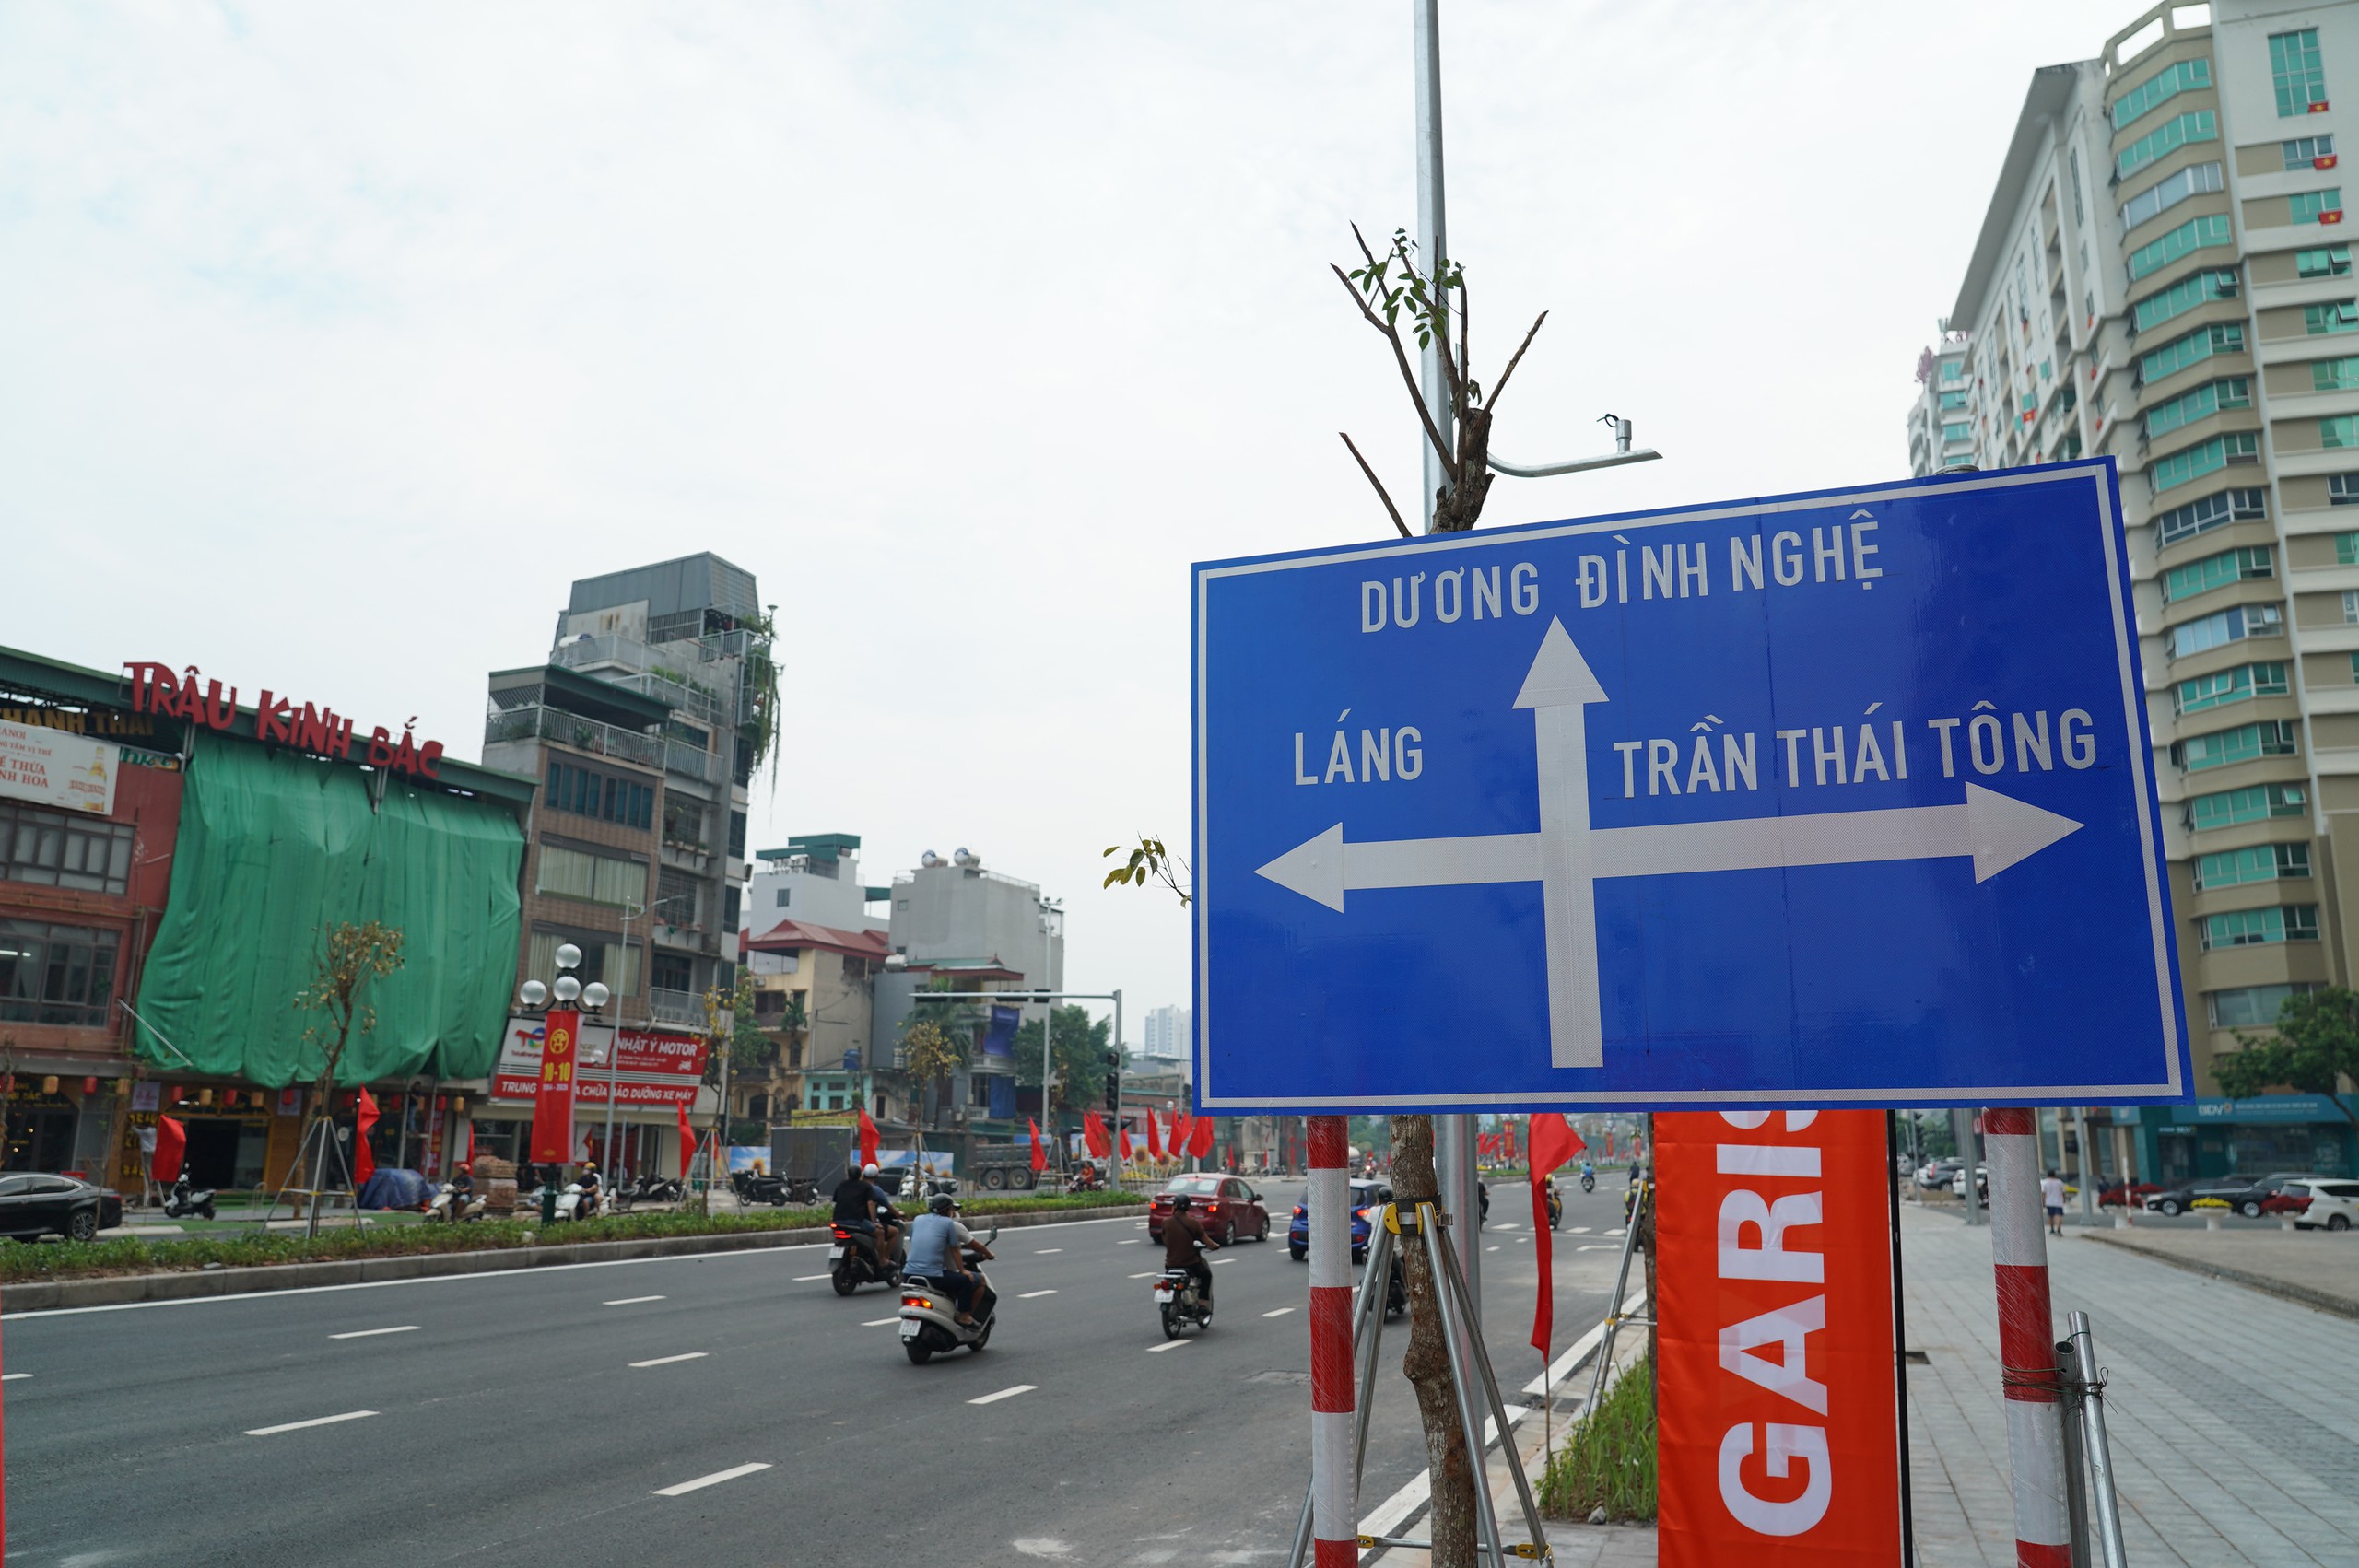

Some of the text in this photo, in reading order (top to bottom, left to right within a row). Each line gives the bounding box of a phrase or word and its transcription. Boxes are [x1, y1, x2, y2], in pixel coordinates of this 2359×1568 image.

[1360, 509, 1884, 634] DƯƠNG ĐÌNH NGHỆ
[0, 707, 86, 734] HANH
[0, 727, 26, 740] ANOI
[123, 661, 237, 731] TRÂU
[369, 716, 445, 779] BẮC
[1295, 708, 1424, 787] LÁNG
[1613, 700, 2097, 798] TRẦN THÁI TÔNG
[22, 774, 49, 789] HOA
[617, 1036, 648, 1054] NHẬT
[658, 1041, 698, 1057] MOTOR
[501, 1081, 538, 1094] TRUNG
[663, 1090, 675, 1100] XE
[2198, 1104, 2224, 1116] BIDV
[1716, 1111, 1832, 1537] GARI
